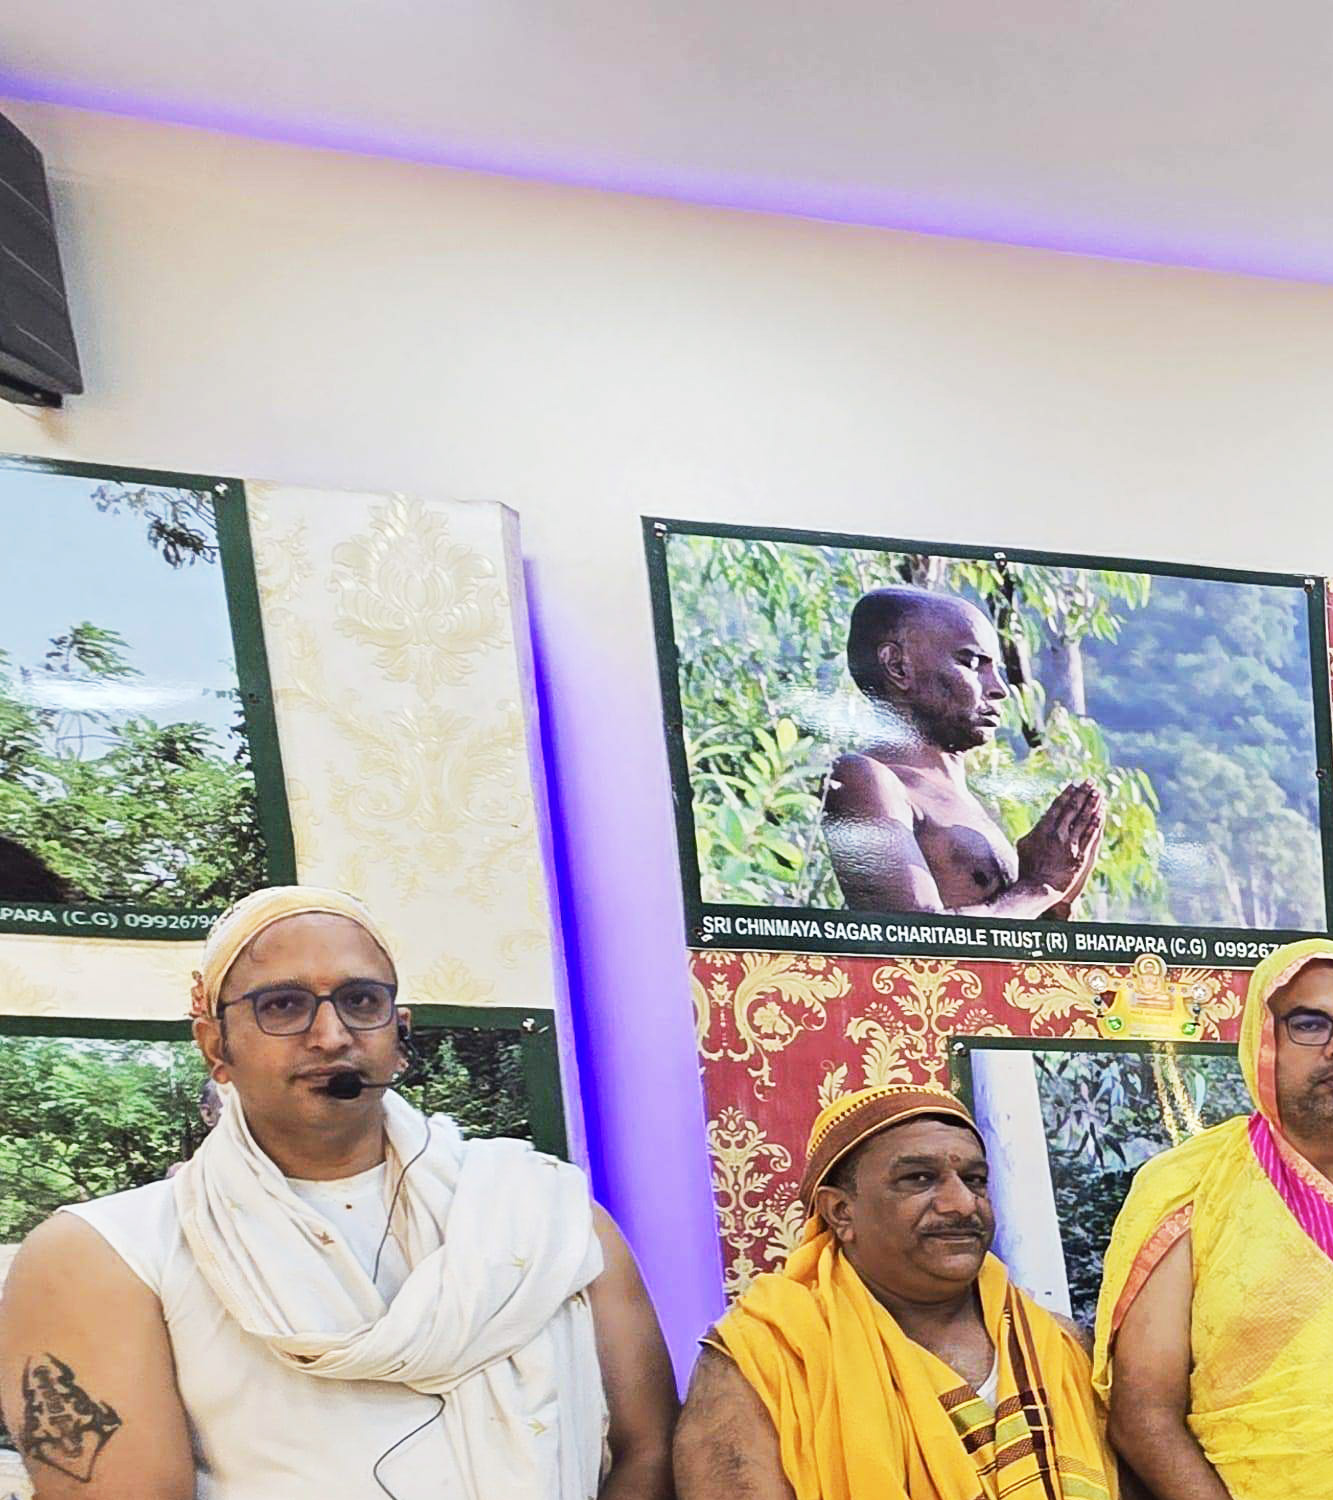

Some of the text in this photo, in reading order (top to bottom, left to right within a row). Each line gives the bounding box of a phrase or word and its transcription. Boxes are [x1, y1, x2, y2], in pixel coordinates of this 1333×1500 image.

[0, 907, 57, 923] PARA
[702, 915, 1288, 959] SRI CHINMAYA SAGAR CHARITABLE TRUST (R) BHATAPARA (C.G) 099267
